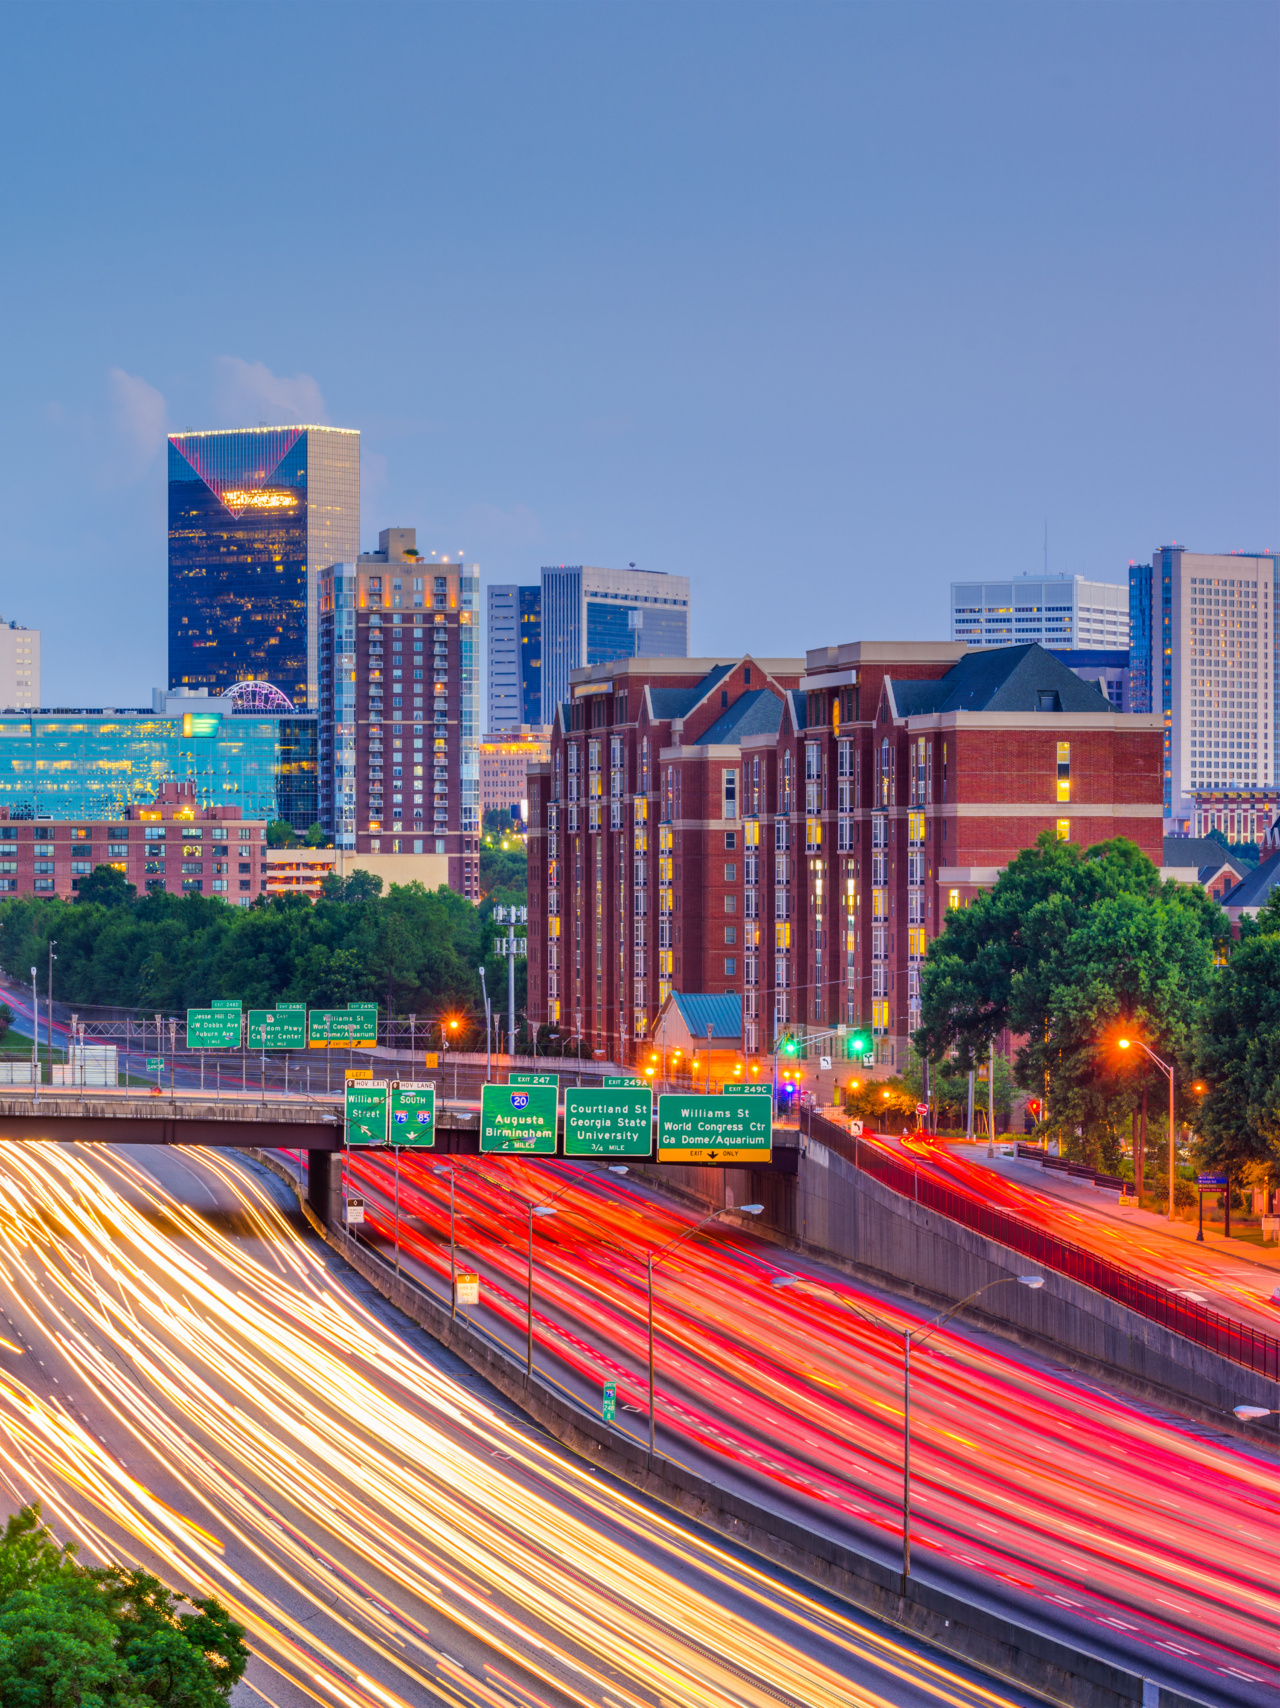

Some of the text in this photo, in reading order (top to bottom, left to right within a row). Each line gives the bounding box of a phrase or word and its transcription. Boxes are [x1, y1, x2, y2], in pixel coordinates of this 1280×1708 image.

[533, 1076, 550, 1084] 247
[623, 1079, 648, 1087] 249A
[348, 1095, 385, 1104] Williams
[400, 1095, 426, 1104] SOUTH
[513, 1096, 527, 1106] 20
[352, 1109, 380, 1118] Street
[570, 1104, 647, 1114] Courtland St
[681, 1108, 750, 1118] Williams St
[396, 1113, 430, 1122] 75 85
[495, 1114, 544, 1127] Augusta
[570, 1117, 647, 1129] Georgia State
[664, 1121, 766, 1134] World Congress Ctr
[485, 1127, 552, 1138] Birmingham
[577, 1130, 639, 1142] University
[502, 1141, 509, 1149] 2
[662, 1135, 765, 1146] Ga Dome/Aquarium
[591, 1143, 604, 1152] 3/4
